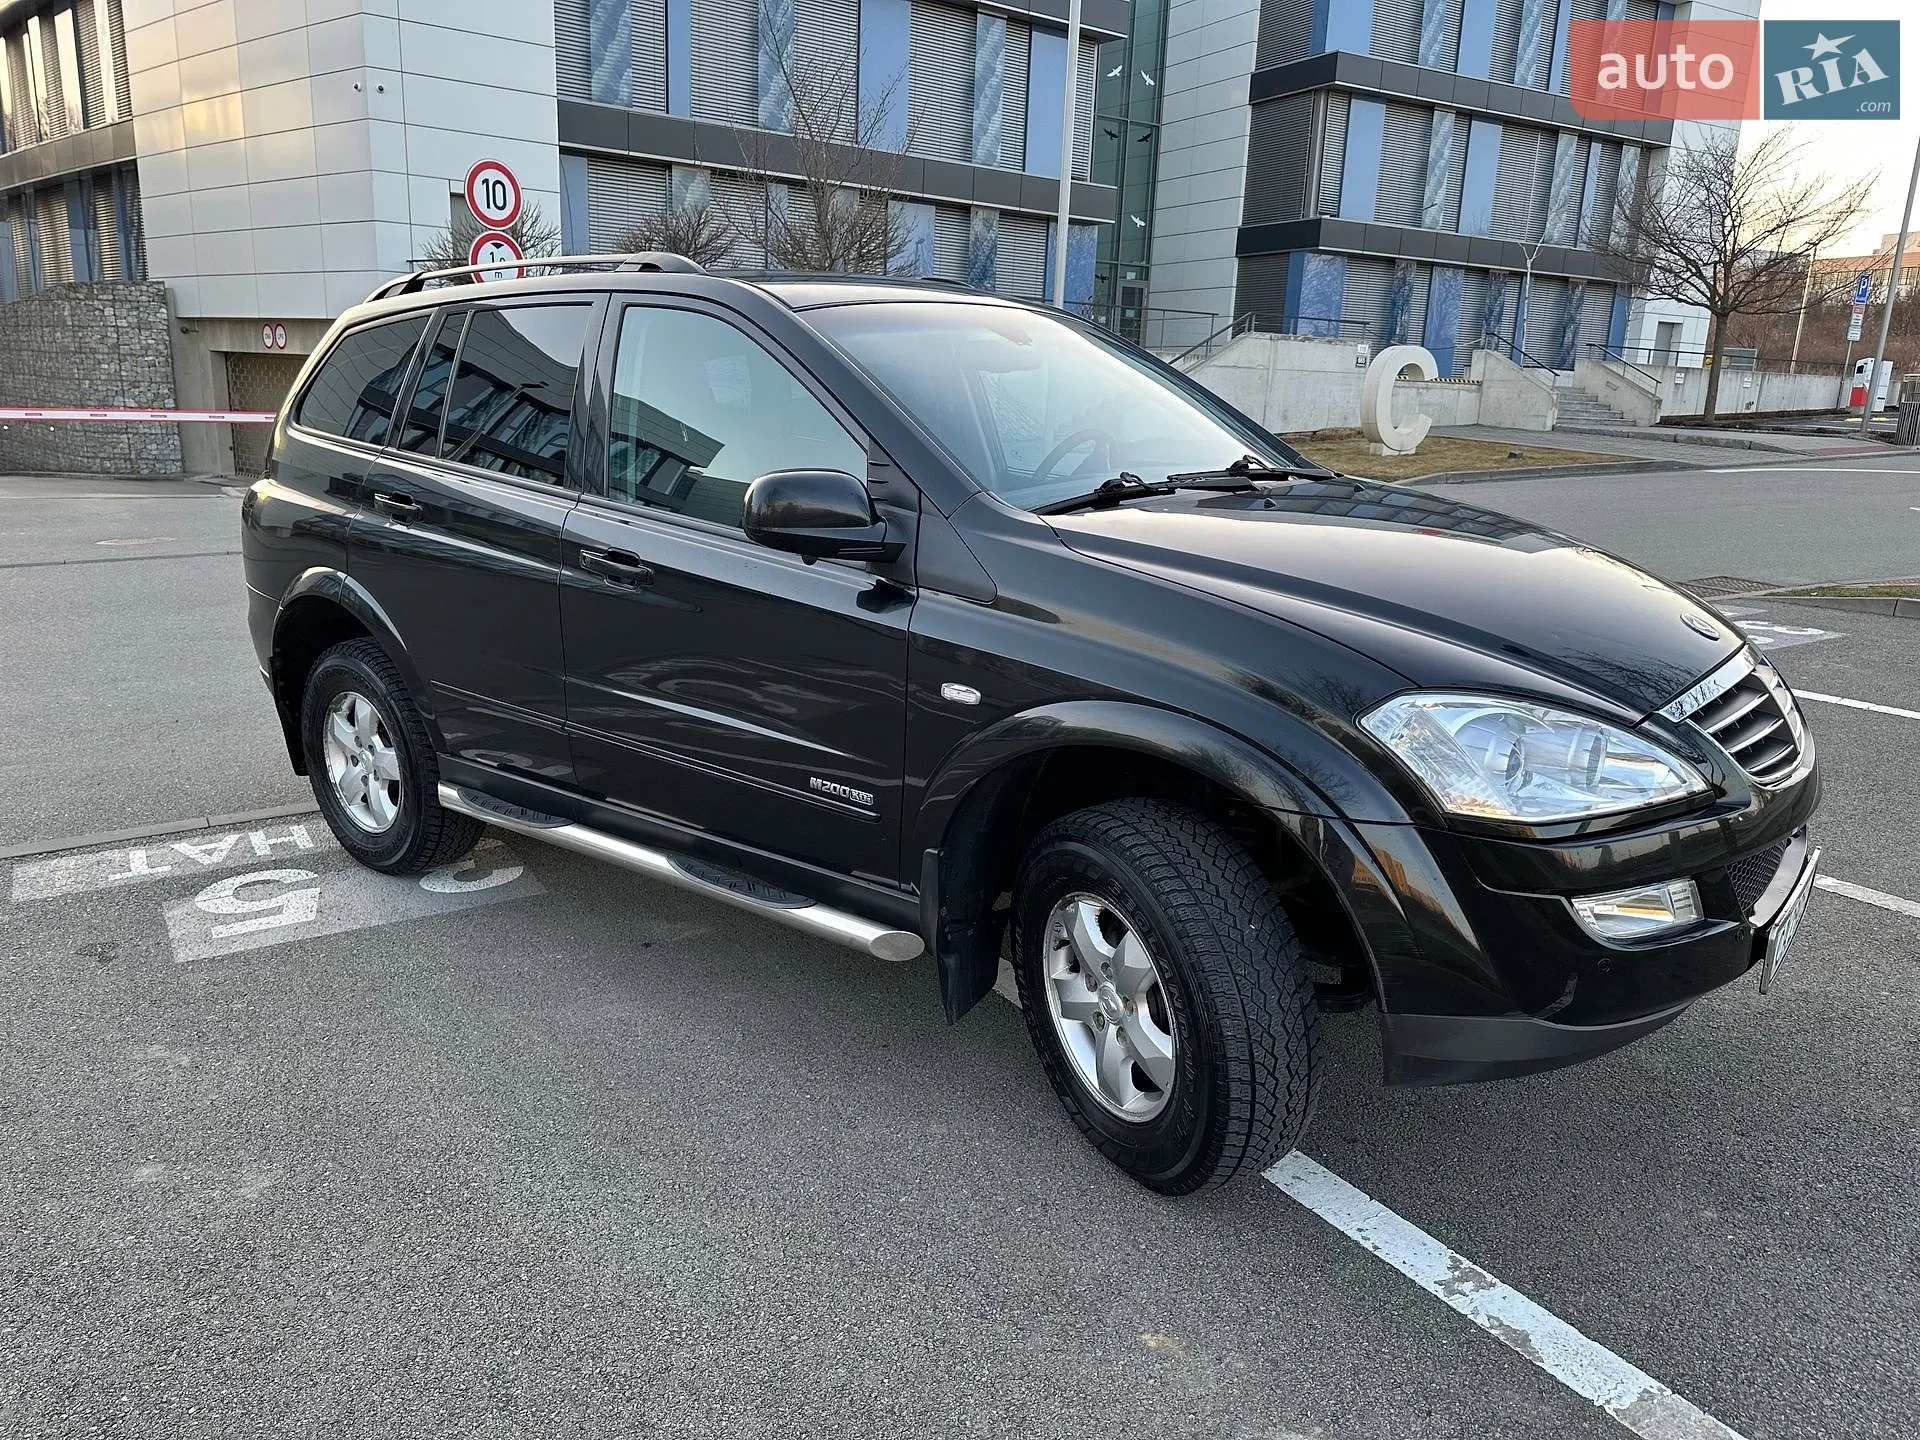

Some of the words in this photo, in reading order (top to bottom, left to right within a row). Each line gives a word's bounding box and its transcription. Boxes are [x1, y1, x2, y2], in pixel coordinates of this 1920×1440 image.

[482, 178, 507, 211] 10
[494, 271, 503, 279] m
[809, 776, 850, 798] M200
[108, 824, 314, 881] HAT
